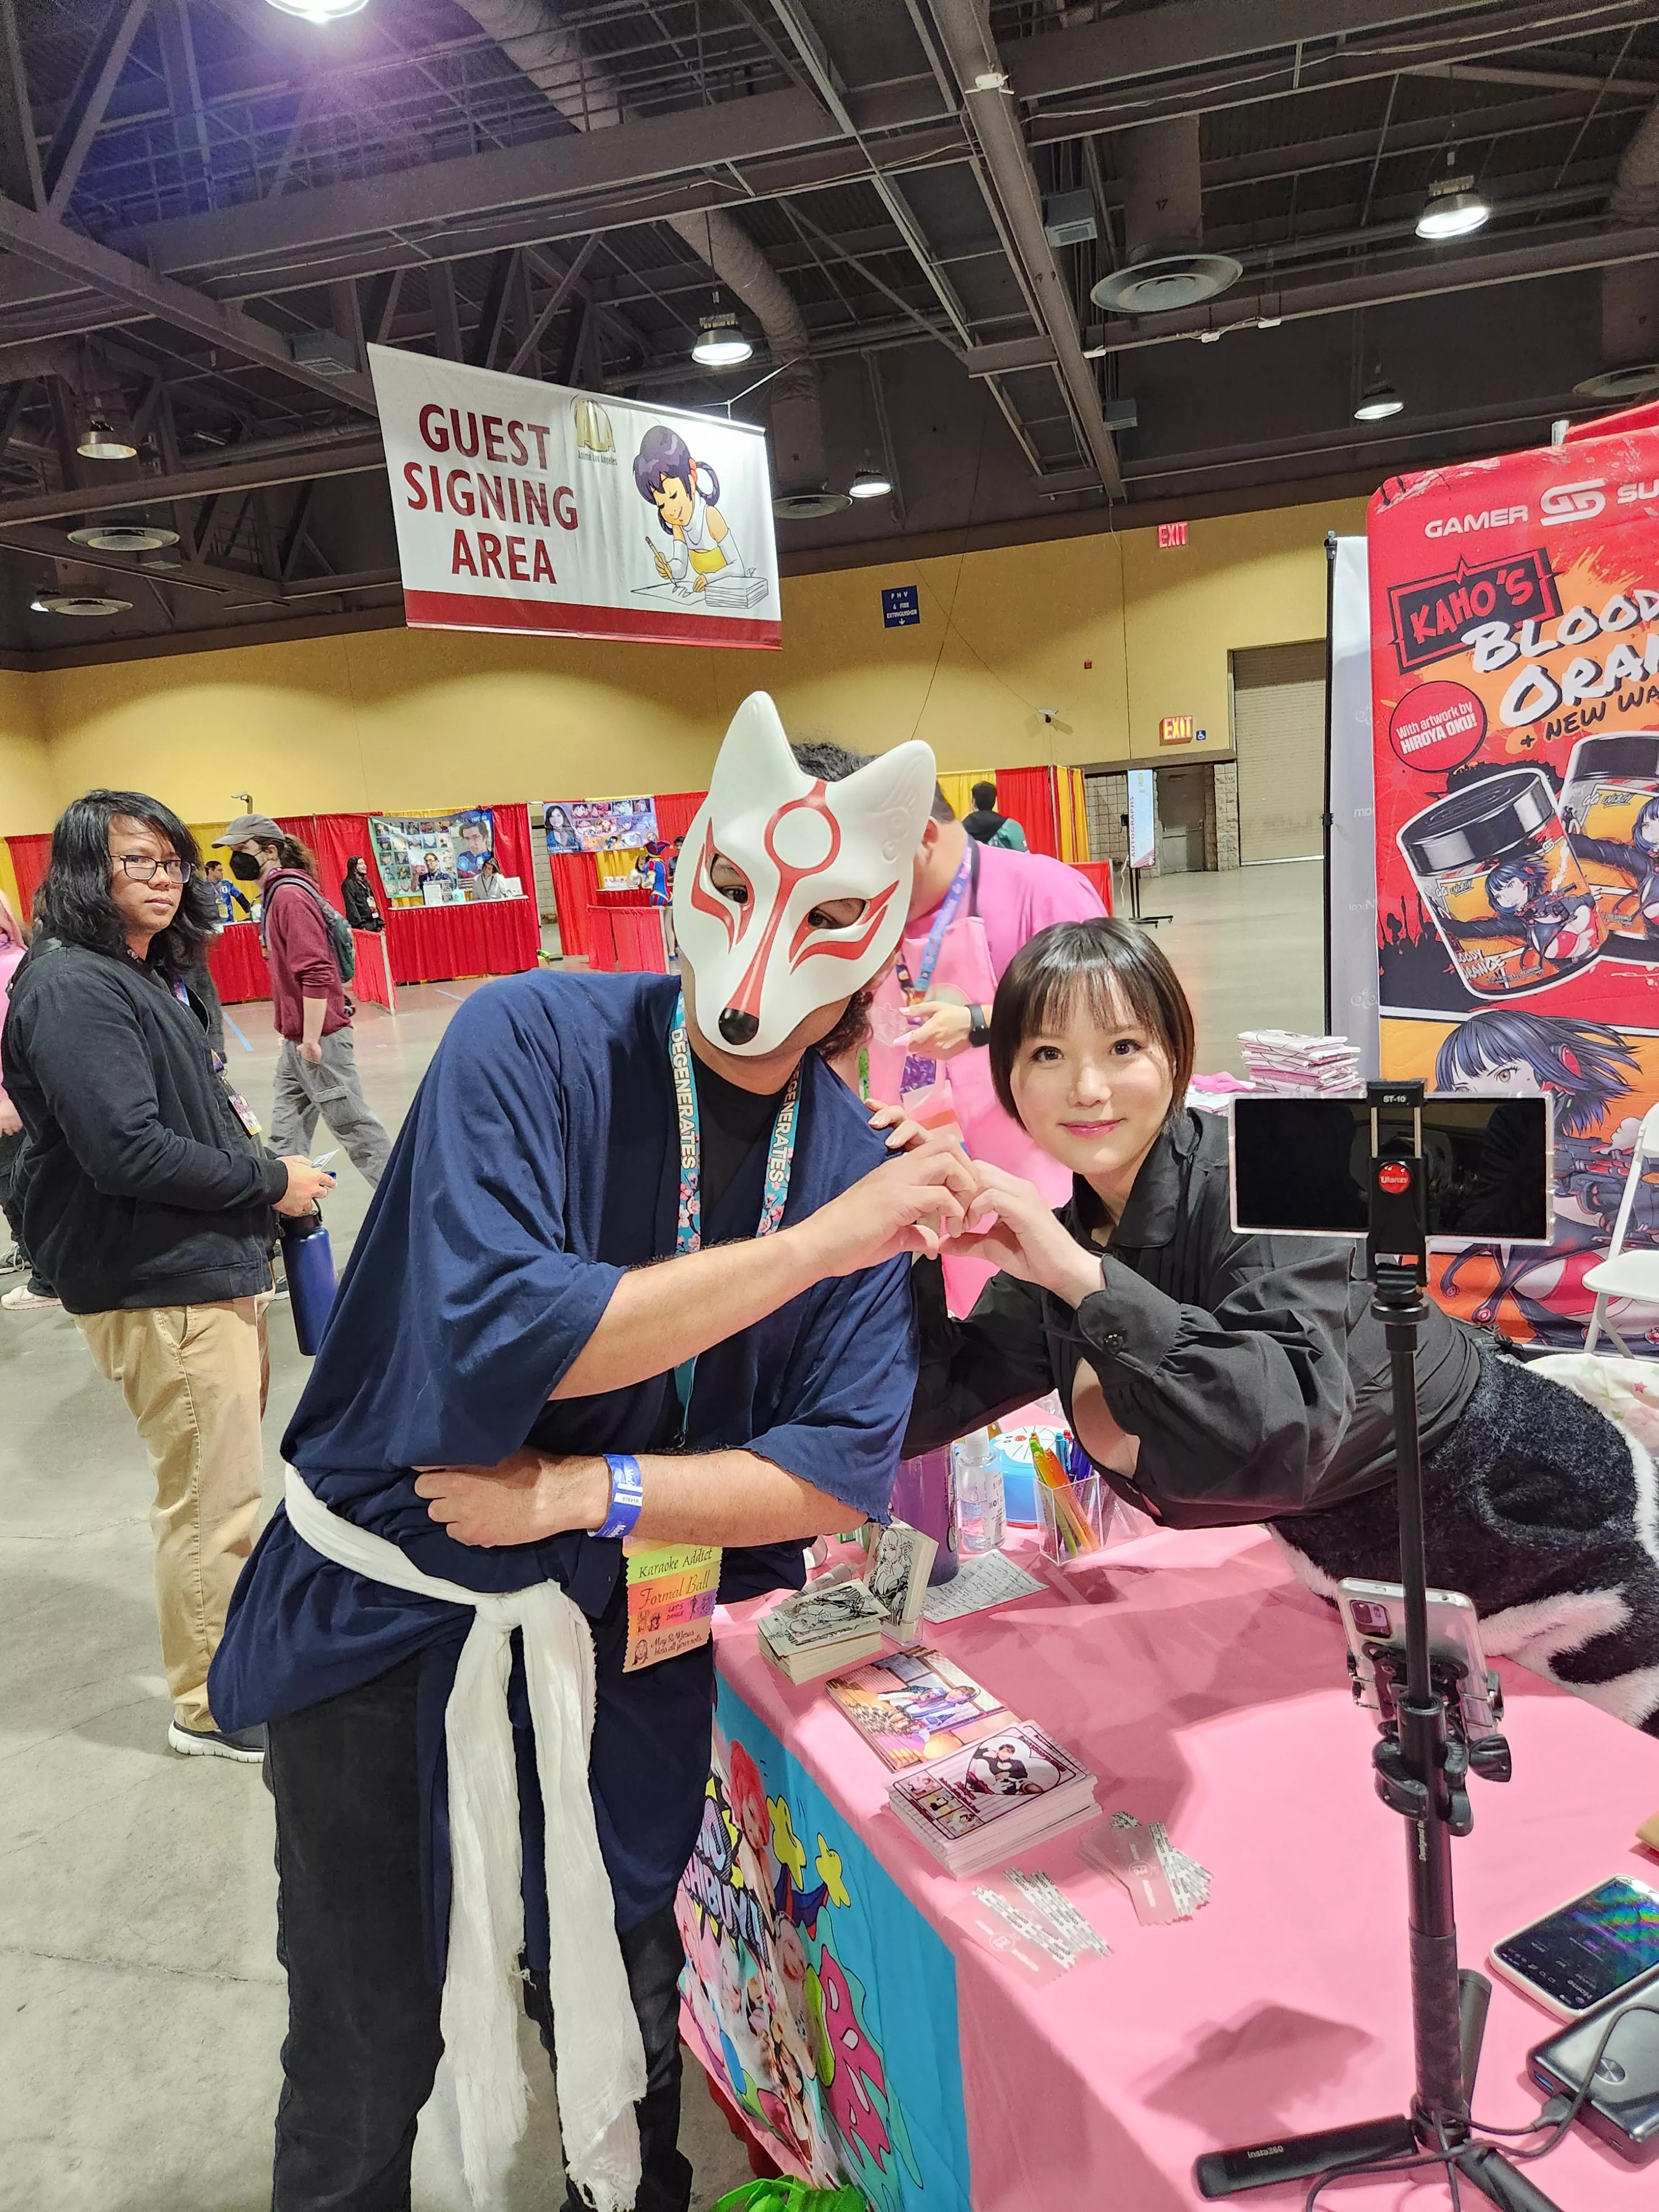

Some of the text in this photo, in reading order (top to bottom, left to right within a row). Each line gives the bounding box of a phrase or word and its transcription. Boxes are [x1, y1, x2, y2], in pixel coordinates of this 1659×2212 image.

[419, 404, 550, 470] GUEST
[601, 455, 618, 466] Angeles
[404, 462, 578, 531] SIGNING
[1159, 522, 1188, 547] EXIT
[1425, 504, 1528, 538] GAMER
[451, 529, 557, 585] AREA
[886, 609, 917, 618] EXTINGUISHER
[1409, 568, 1533, 644] KAHO'S
[1461, 588, 1659, 673] BLOOD
[1164, 716, 1192, 739] EXIT
[1396, 701, 1473, 739] With artwork by
[1400, 712, 1478, 754] HIROYA OKU!
[1546, 701, 1606, 740] NEW
[671, 1028, 697, 1170] DEGENERATES
[1383, 1094, 1407, 1103] ST-10
[638, 1547, 713, 1578] Karaoke Addict
[638, 1569, 711, 1610] Formal Ball
[666, 1610, 685, 1620] DANCE
[668, 1603, 684, 1613] LET'S
[1247, 2145, 1284, 2159] Insta360
